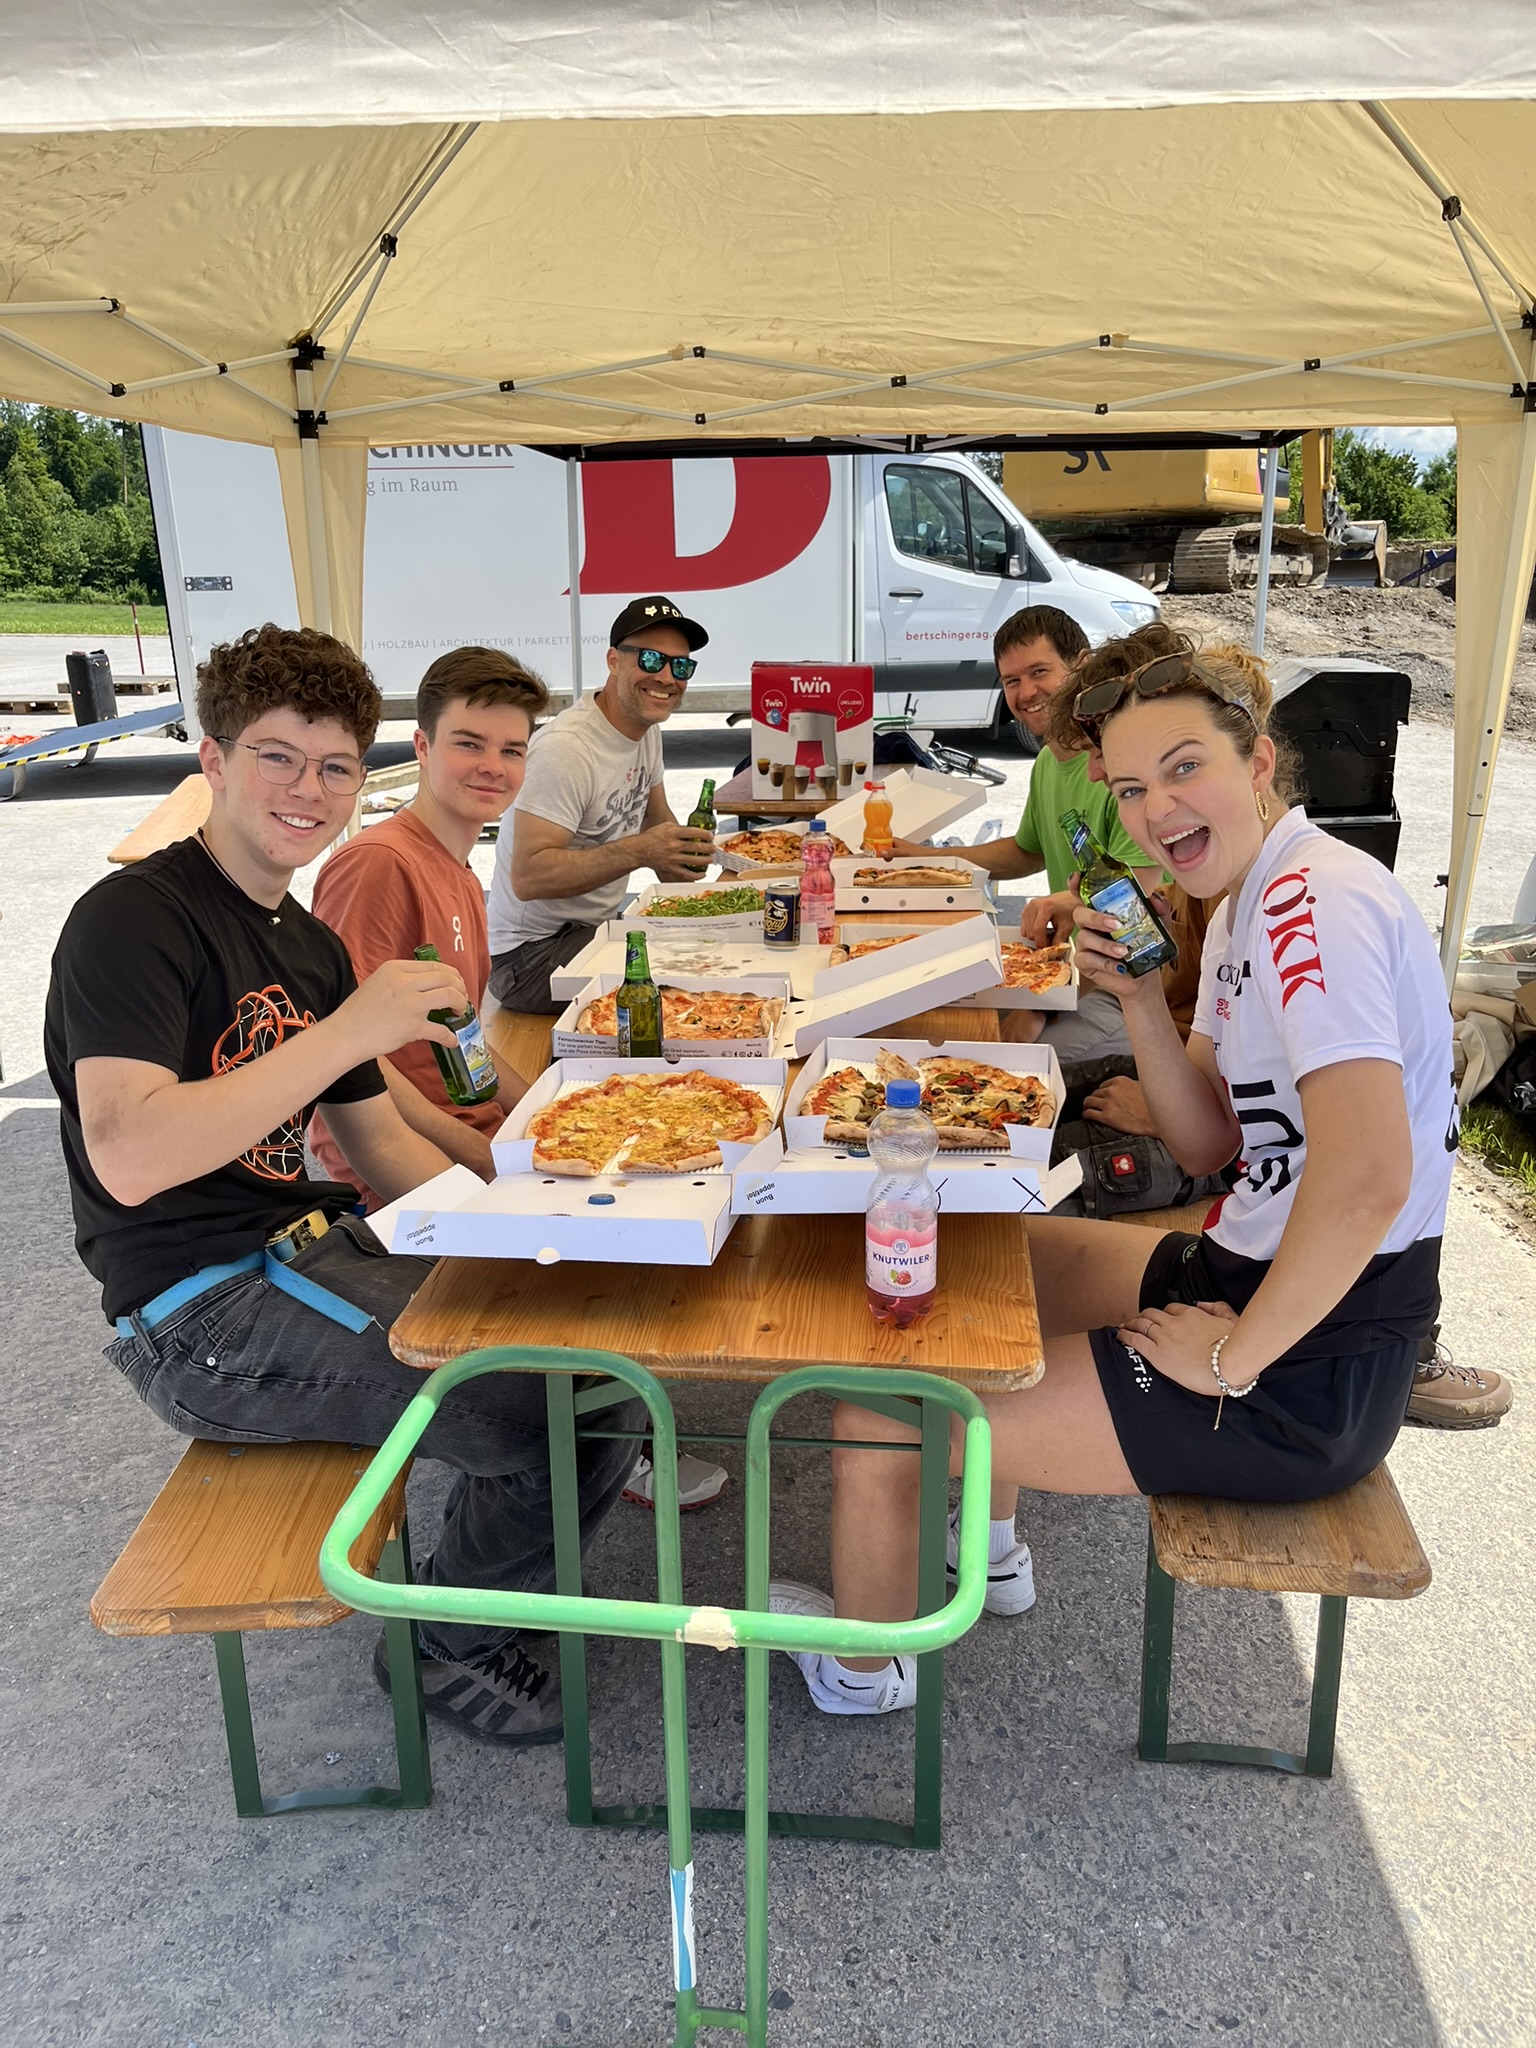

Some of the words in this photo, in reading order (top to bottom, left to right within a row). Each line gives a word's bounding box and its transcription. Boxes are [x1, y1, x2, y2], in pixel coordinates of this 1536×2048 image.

[369, 444, 513, 459] CHINGER
[381, 477, 404, 493] im
[410, 478, 458, 493] Raum
[661, 605, 682, 618] FO
[378, 639, 429, 650] HOLZBAU
[439, 635, 514, 648] ARCHITEKTUR
[525, 636, 570, 646] PARKETT
[581, 634, 611, 645] WOH
[755, 1193, 775, 1205] Buon
[415, 1234, 435, 1246] Buon
[872, 1251, 930, 1266] KNUTWILER
[1122, 1344, 1147, 1375] AFT
[888, 1685, 900, 1707] NIKE
